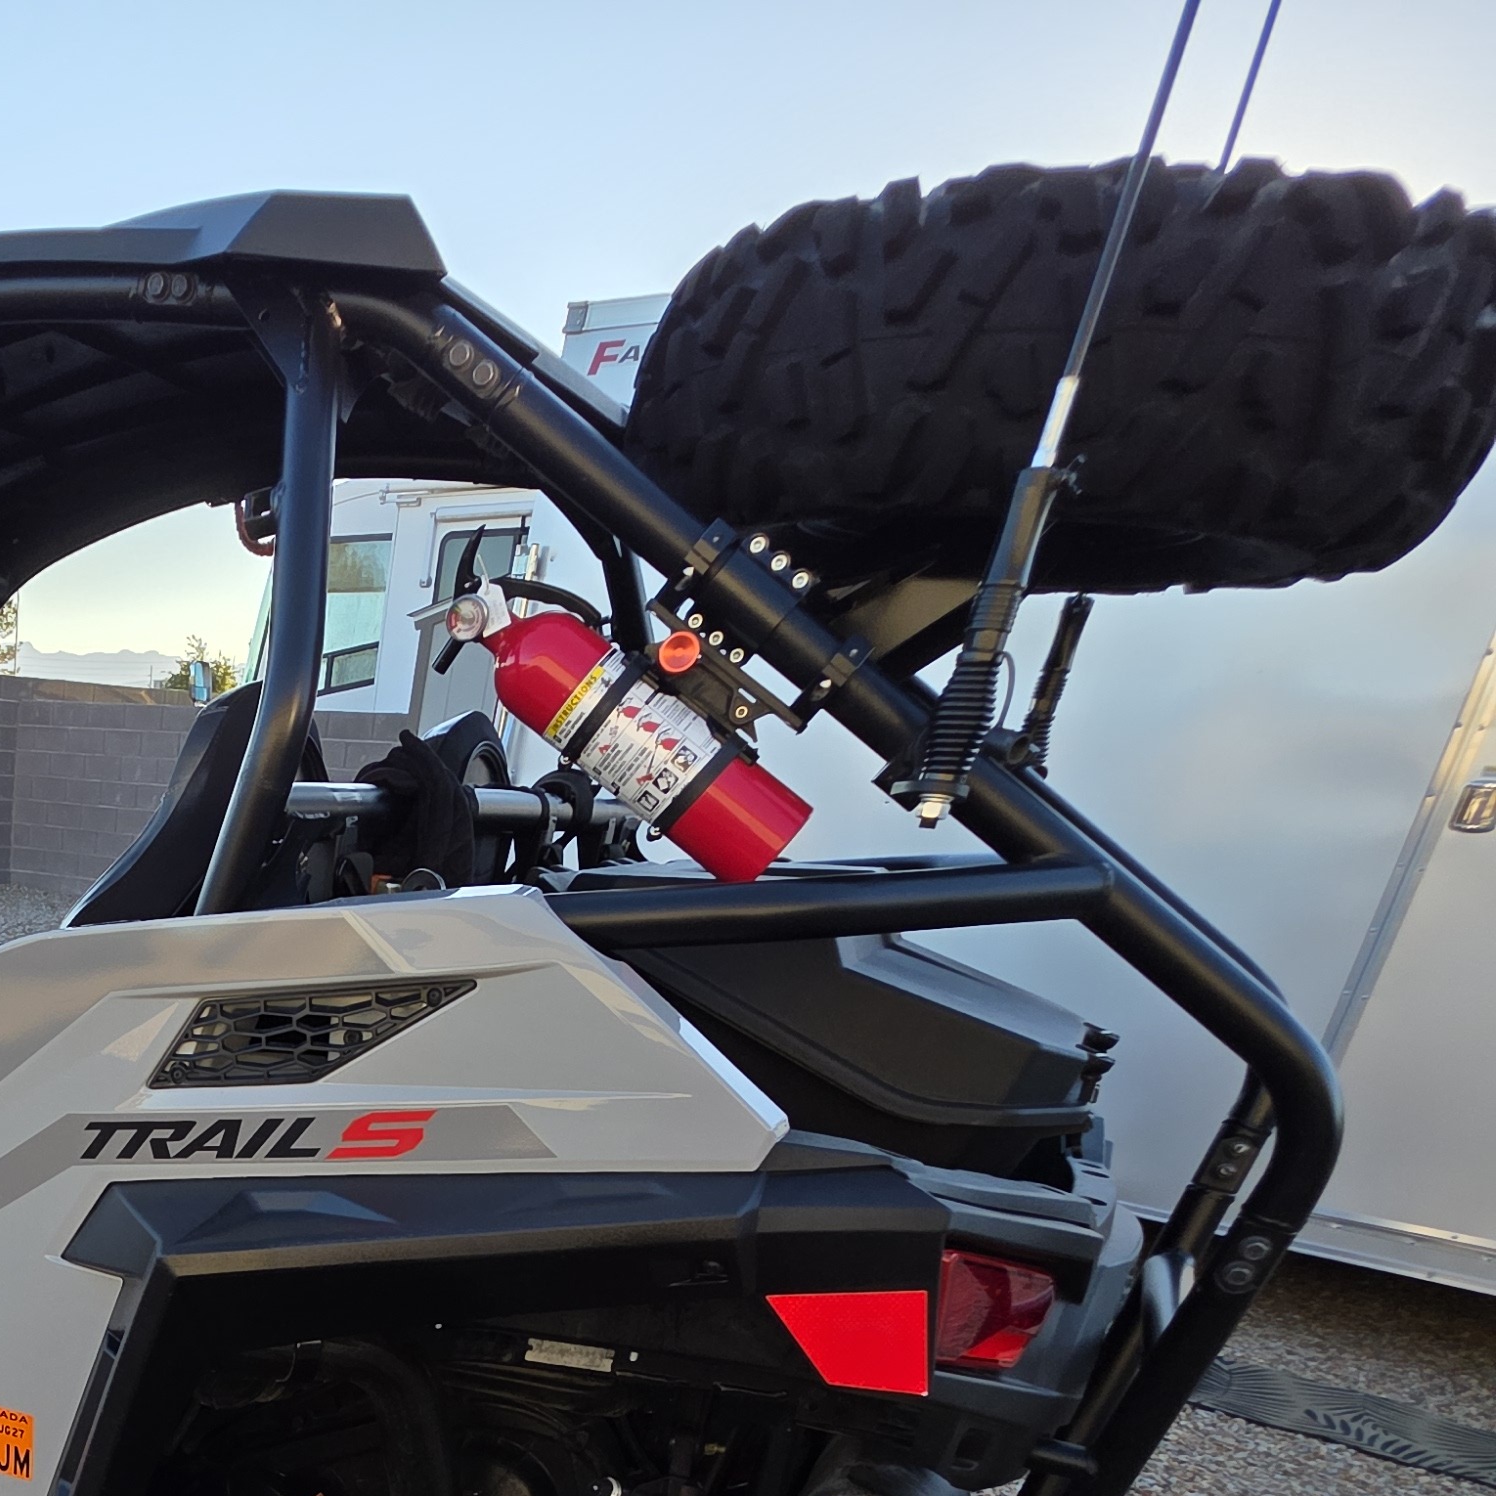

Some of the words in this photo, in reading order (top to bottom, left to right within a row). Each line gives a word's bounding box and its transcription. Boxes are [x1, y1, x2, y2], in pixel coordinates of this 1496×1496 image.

[587, 339, 640, 376] FA
[551, 674, 597, 732] INSTRUCTIONS
[80, 1117, 321, 1160] TRAIL
[325, 1109, 438, 1161] S
